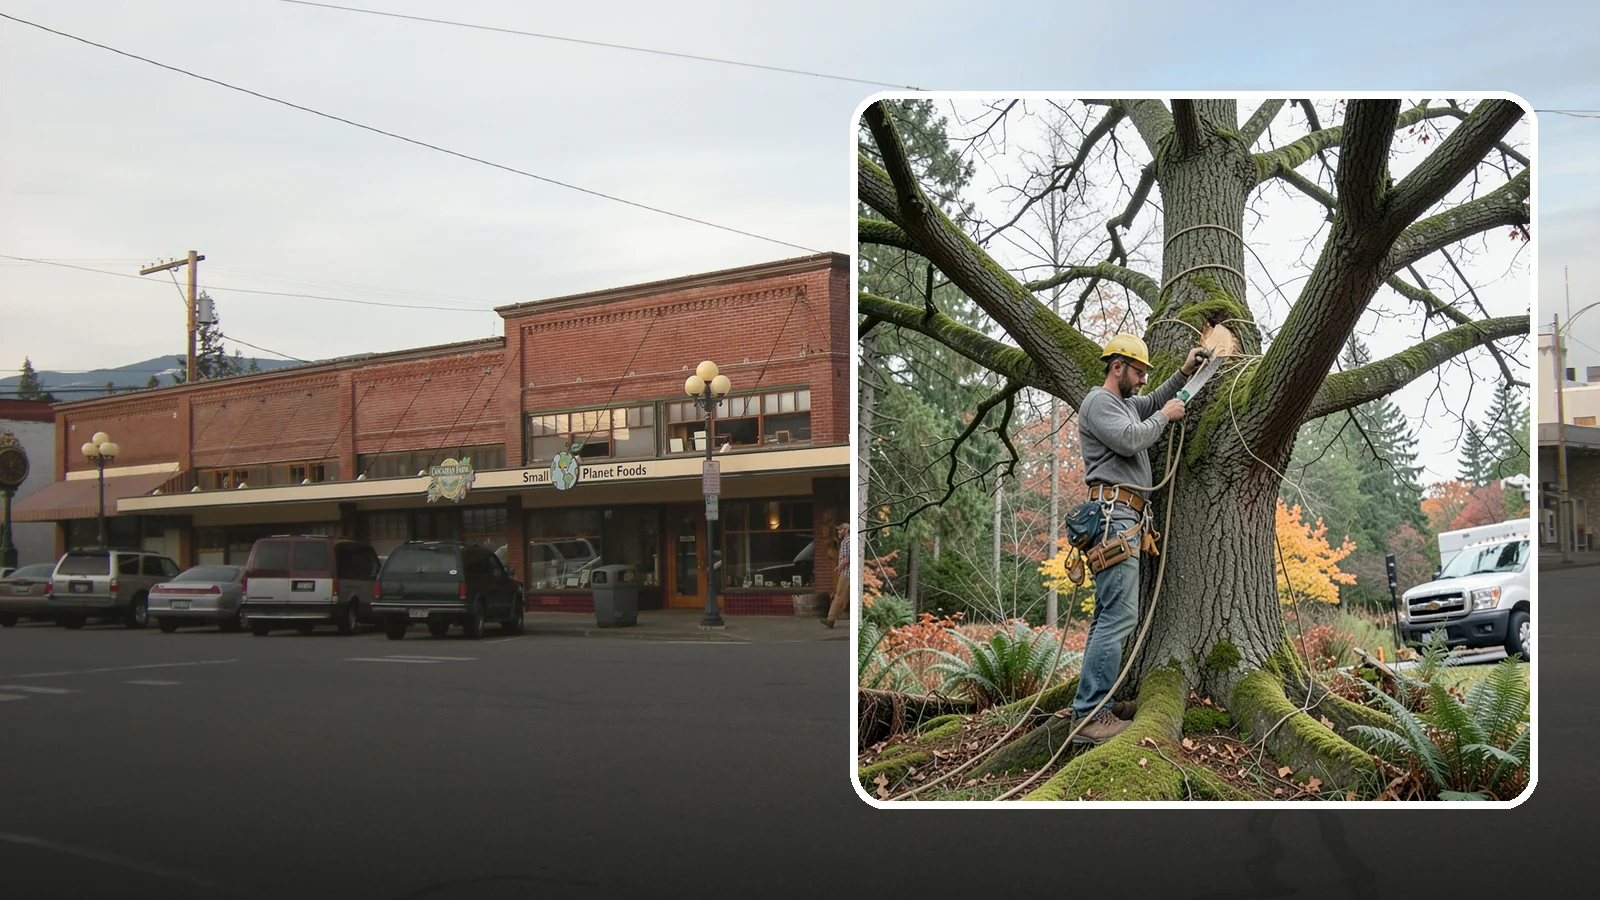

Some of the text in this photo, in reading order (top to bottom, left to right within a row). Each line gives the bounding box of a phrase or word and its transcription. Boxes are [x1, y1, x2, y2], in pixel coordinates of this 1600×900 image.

[523, 464, 647, 483] Small Planet Foods
